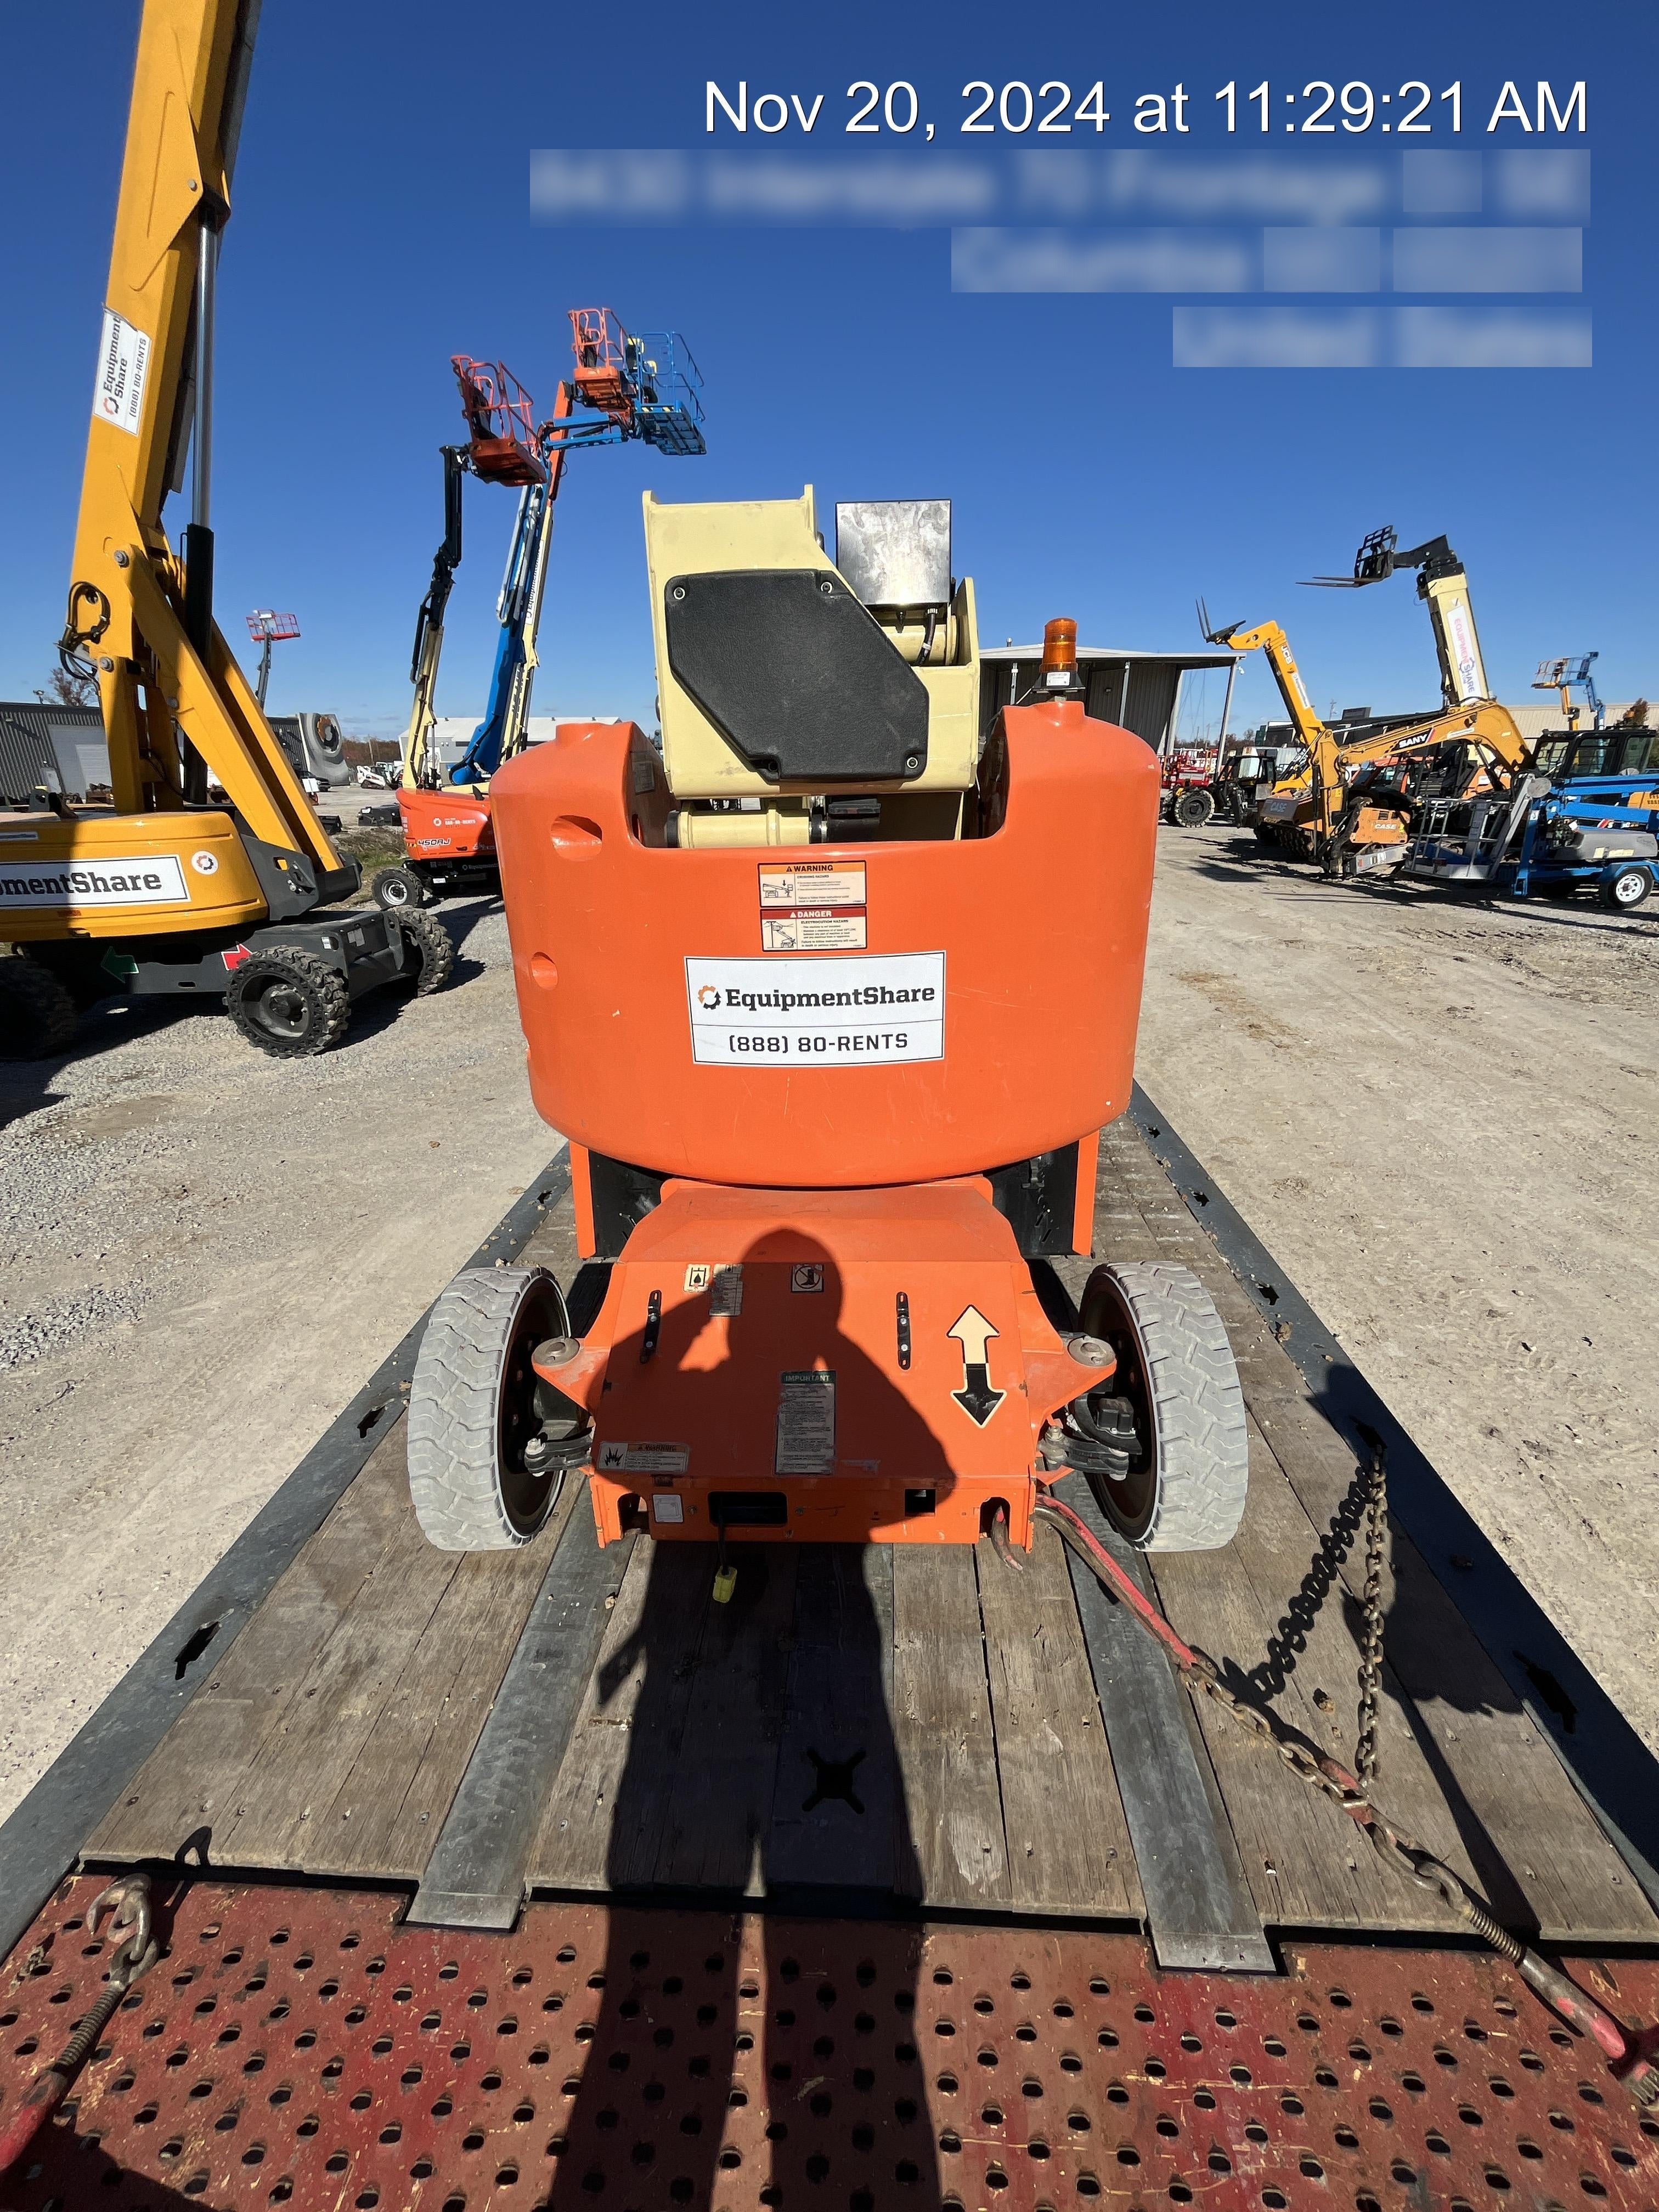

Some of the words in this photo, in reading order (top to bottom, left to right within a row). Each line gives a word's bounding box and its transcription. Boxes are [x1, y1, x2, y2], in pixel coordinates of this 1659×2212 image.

[103, 316, 121, 393] Equipment
[114, 358, 128, 399] Share
[1280, 645, 1294, 665] JCB
[1464, 664, 1475, 693] SHARE
[1399, 733, 1428, 748] SANY
[1269, 802, 1287, 812] CASE
[0, 872, 162, 895] mentShare
[725, 986, 935, 1012] EquipmentShare
[729, 1035, 788, 1053] (888)
[798, 1033, 907, 1052] 80-RENTS
